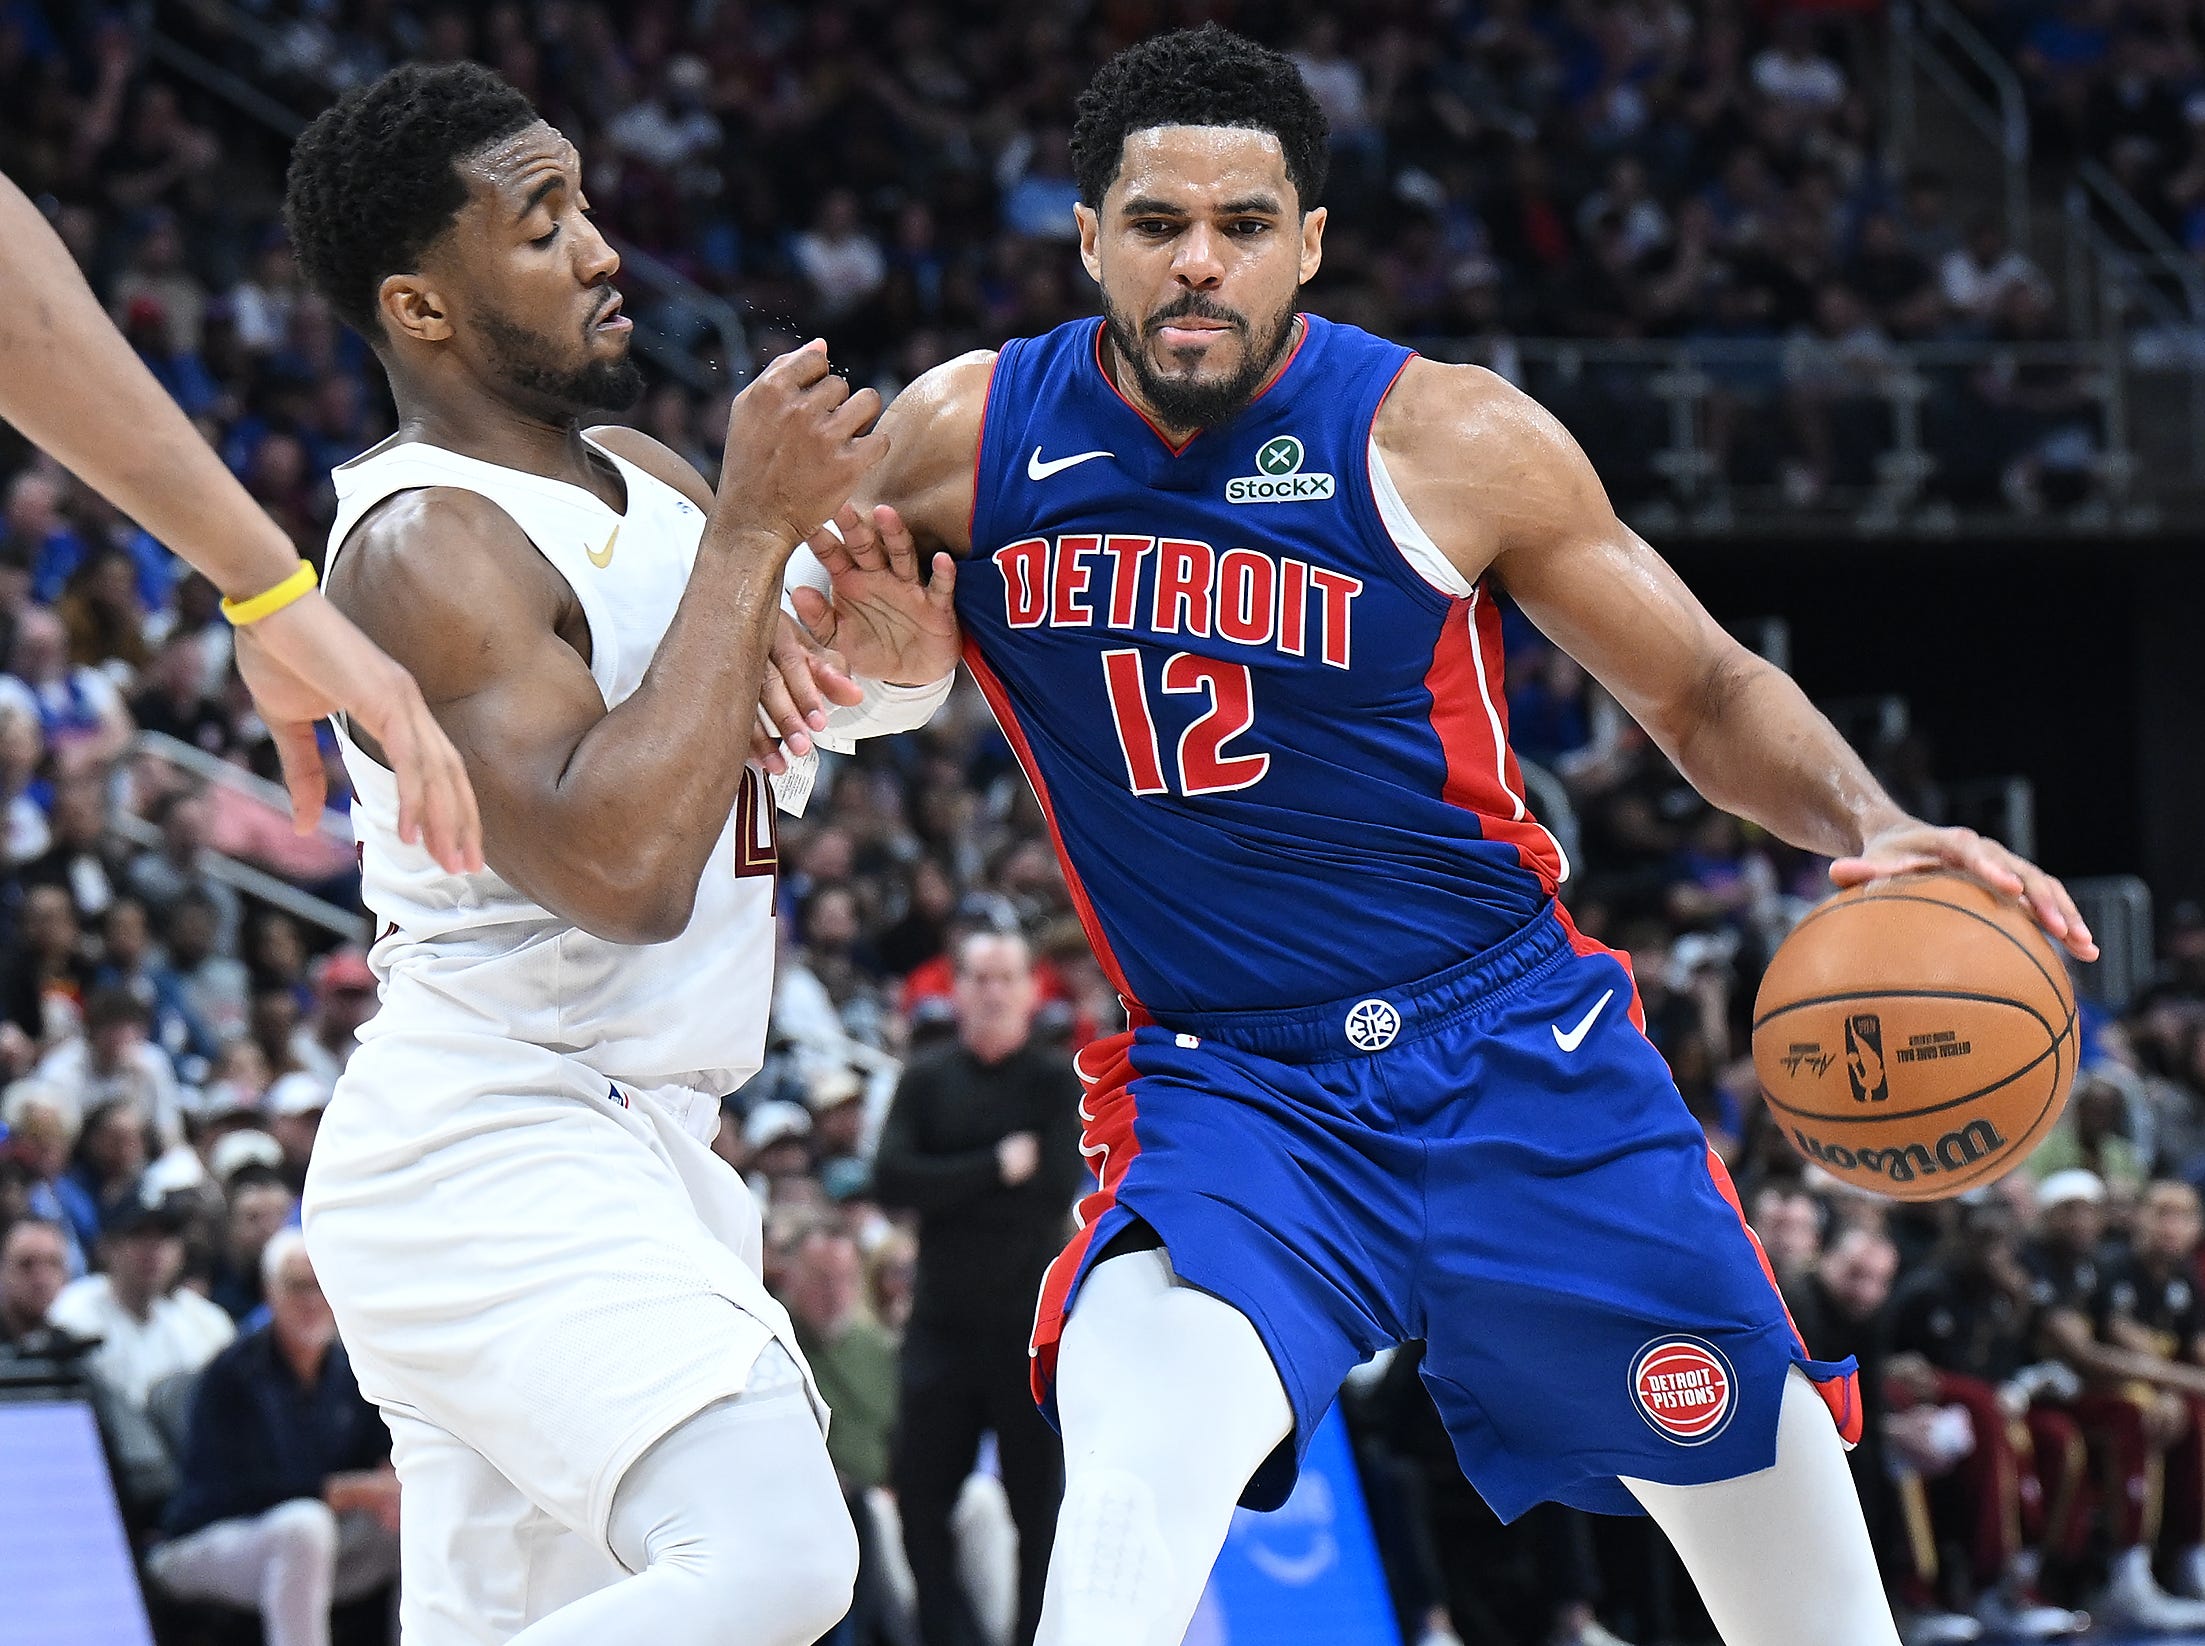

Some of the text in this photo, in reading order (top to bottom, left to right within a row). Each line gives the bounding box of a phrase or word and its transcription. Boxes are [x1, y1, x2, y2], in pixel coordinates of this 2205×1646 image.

[1229, 477, 1329, 499] StockX
[992, 534, 1363, 670] DETROIT
[1101, 648, 1270, 796] 12
[1896, 1049, 1914, 1063] BALL
[1791, 1119, 2008, 1182] Wilson
[1647, 1368, 1710, 1392] DETROIT
[1651, 1386, 1716, 1409] PISTONS
